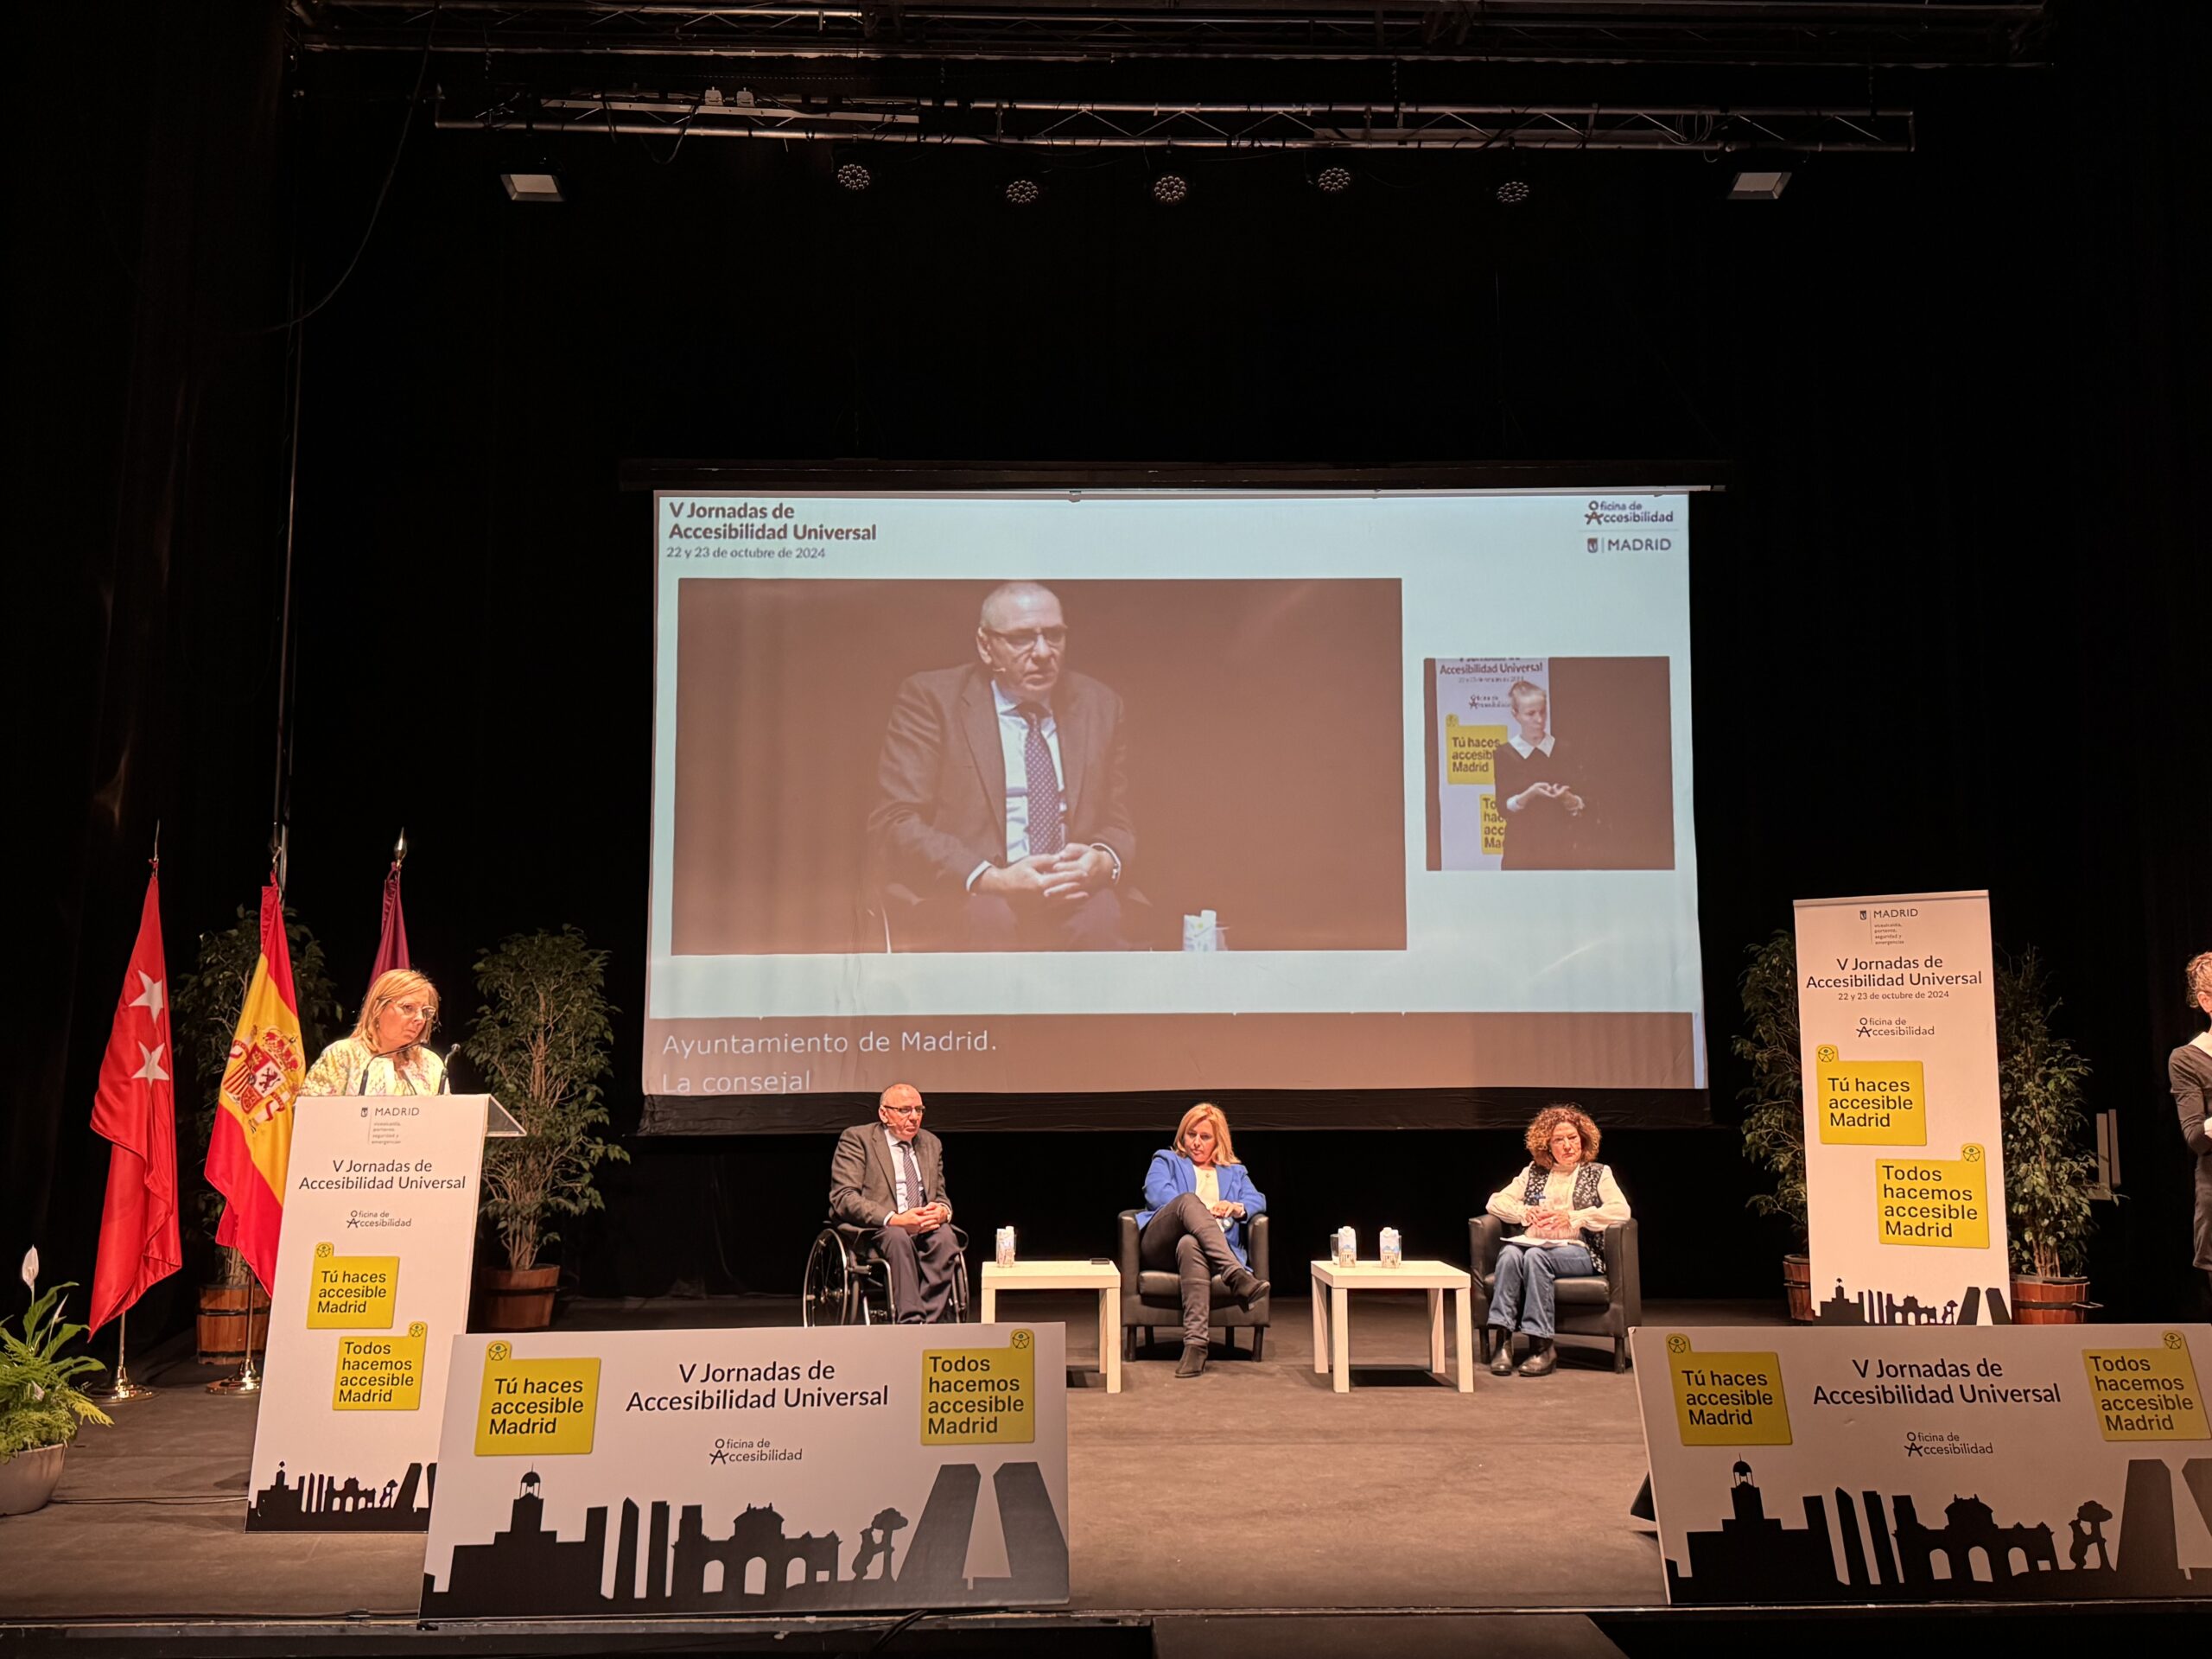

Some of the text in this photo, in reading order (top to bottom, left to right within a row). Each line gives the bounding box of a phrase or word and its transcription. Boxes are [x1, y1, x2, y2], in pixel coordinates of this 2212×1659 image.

[669, 502, 795, 518] V Jornadas de
[1588, 501, 1642, 512] Oficina de
[1585, 511, 1674, 525] Accesibilidad
[669, 523, 876, 541] Accesibilidad Universal
[1608, 538, 1671, 551] MADRID
[666, 547, 825, 561] 22 y 23 de octubre de 2024
[1440, 662, 1542, 674] Accesibilidad Universal
[1452, 737, 1500, 747] Tú haces
[1452, 750, 1494, 760] accesib
[1452, 761, 1489, 772] Madrid
[1873, 908, 1918, 918] MADRID
[1836, 956, 1942, 970] V Jornadas de
[1807, 971, 1982, 988] Accesibilidad Universal
[1881, 991, 1913, 1000] octubre
[1928, 990, 1949, 999] 2024
[1859, 1017, 1892, 1026] Oficina
[1856, 1026, 1935, 1037] Accesibilidad
[662, 1031, 996, 1059] Ayuntamiento de Madrid.
[663, 1071, 810, 1094] La consejal
[1827, 1077, 1910, 1092] Tú haces
[1828, 1096, 1913, 1109] accesible
[375, 1107, 420, 1116] MADRID
[1830, 1113, 1891, 1127] Madrid
[333, 1159, 432, 1173] V Jornadas de
[1882, 1166, 1942, 1181] Todos
[299, 1176, 466, 1189] Accesibilidad Universal
[1884, 1184, 1973, 1201] hacemos
[1885, 1204, 1978, 1220] accesible
[346, 1218, 412, 1229] Accesibilidad
[1885, 1221, 1952, 1237] Madrid
[321, 1270, 386, 1283] Tú haces
[319, 1286, 387, 1298] accesible
[317, 1300, 367, 1313] Madrid
[344, 1341, 391, 1355] Todos
[342, 1357, 412, 1370] hacemos
[679, 1359, 835, 1382] V Jornadas de
[929, 1356, 990, 1373] Todos
[1852, 1357, 2003, 1378] V Jornadas de
[2089, 1355, 2151, 1372] Todos
[340, 1373, 414, 1386] accesible
[929, 1376, 1020, 1394] hacemos
[1681, 1370, 1768, 1386] Tú haces
[2094, 1376, 2184, 1392] hacemos
[494, 1377, 583, 1395] Tú haces
[1814, 1382, 2061, 1405] Accesibilidad Universal
[339, 1389, 392, 1402] Madrid
[626, 1385, 888, 1412] Accesibilidad Universal
[1686, 1389, 1773, 1406] accesible
[2101, 1394, 2194, 1411] accesible
[491, 1397, 584, 1414] accesible
[928, 1396, 1024, 1414] accesible
[1688, 1409, 1753, 1426] Madrid
[2105, 1414, 2174, 1432] Madrid
[489, 1418, 556, 1435] Madrid
[928, 1417, 998, 1435] Madrid
[715, 1439, 771, 1449] Oficina de
[1907, 1432, 1960, 1442] Oficina de
[709, 1449, 803, 1465] Accesibilidad
[1904, 1442, 1993, 1458] Accesibilidad
